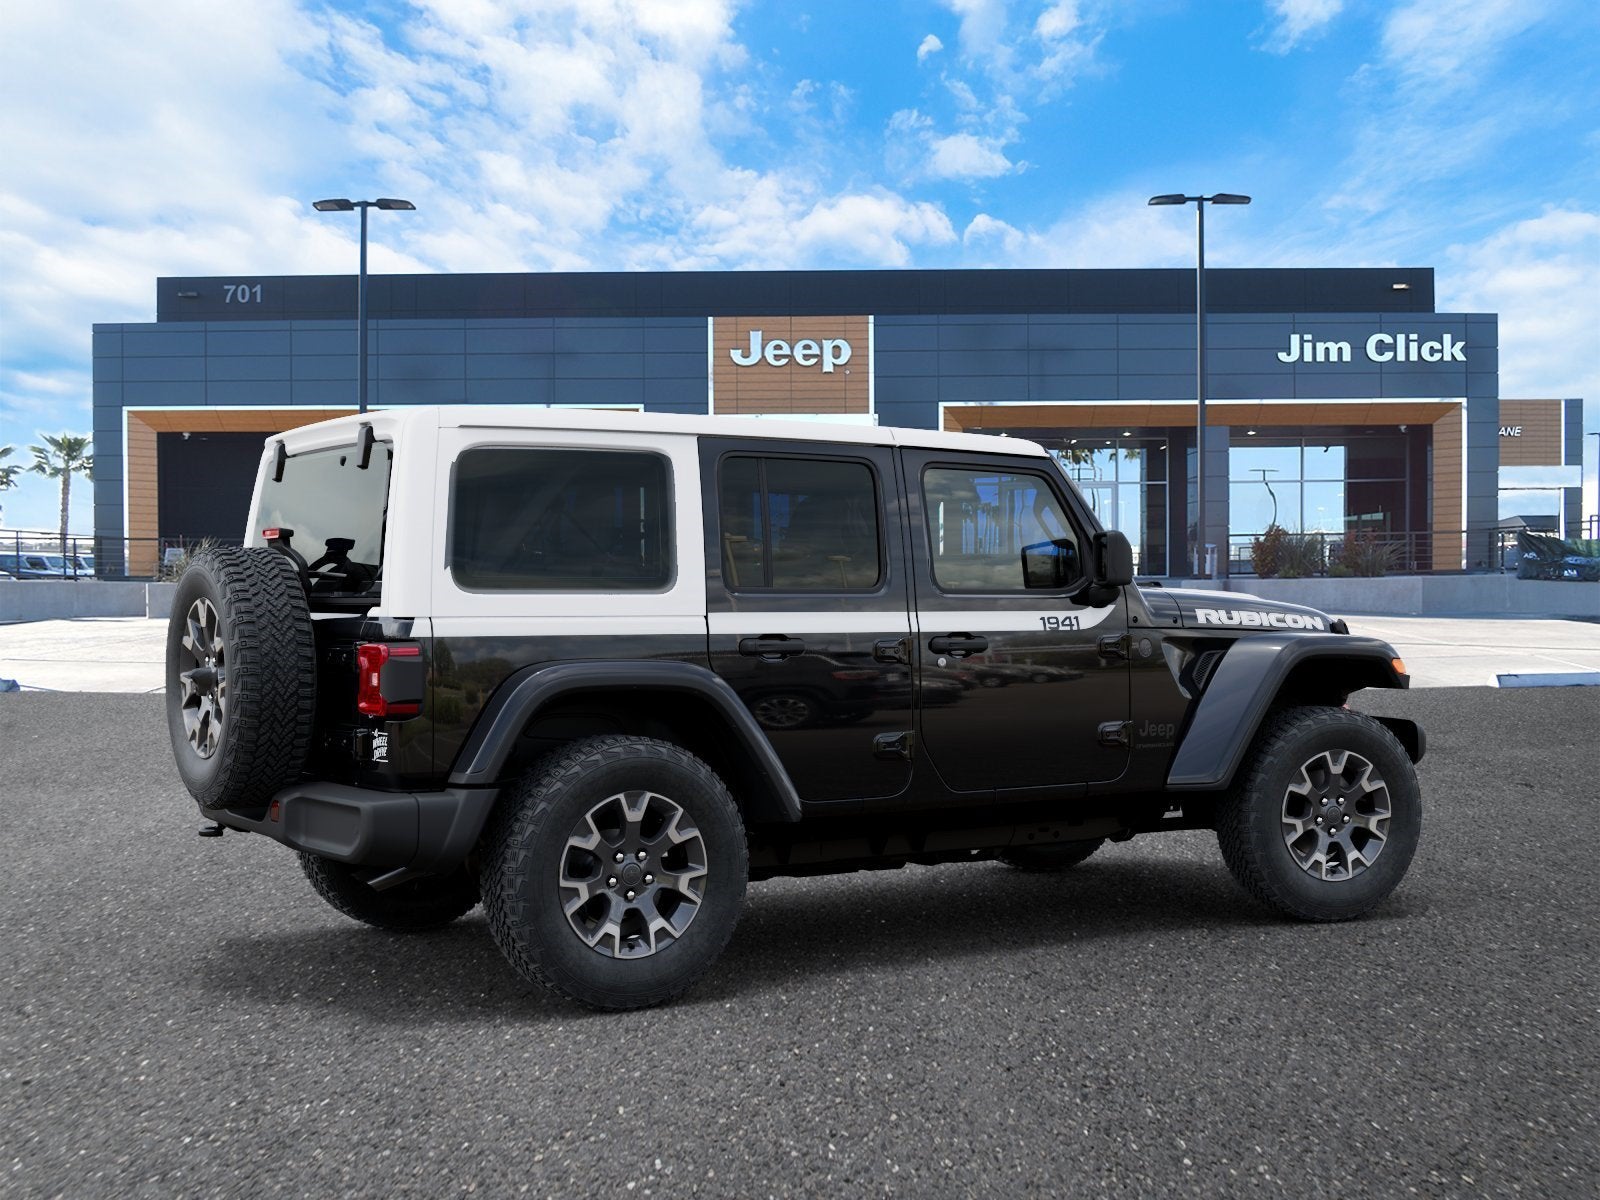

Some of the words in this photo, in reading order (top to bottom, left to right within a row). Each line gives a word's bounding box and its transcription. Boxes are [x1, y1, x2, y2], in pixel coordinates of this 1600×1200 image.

[223, 284, 262, 304] 701
[729, 330, 852, 373] Jeep
[1277, 333, 1352, 363] Jim
[1365, 333, 1467, 363] Click
[1039, 615, 1081, 631] 1941
[1194, 608, 1325, 631] RUBICON
[1138, 719, 1175, 740] Jeep
